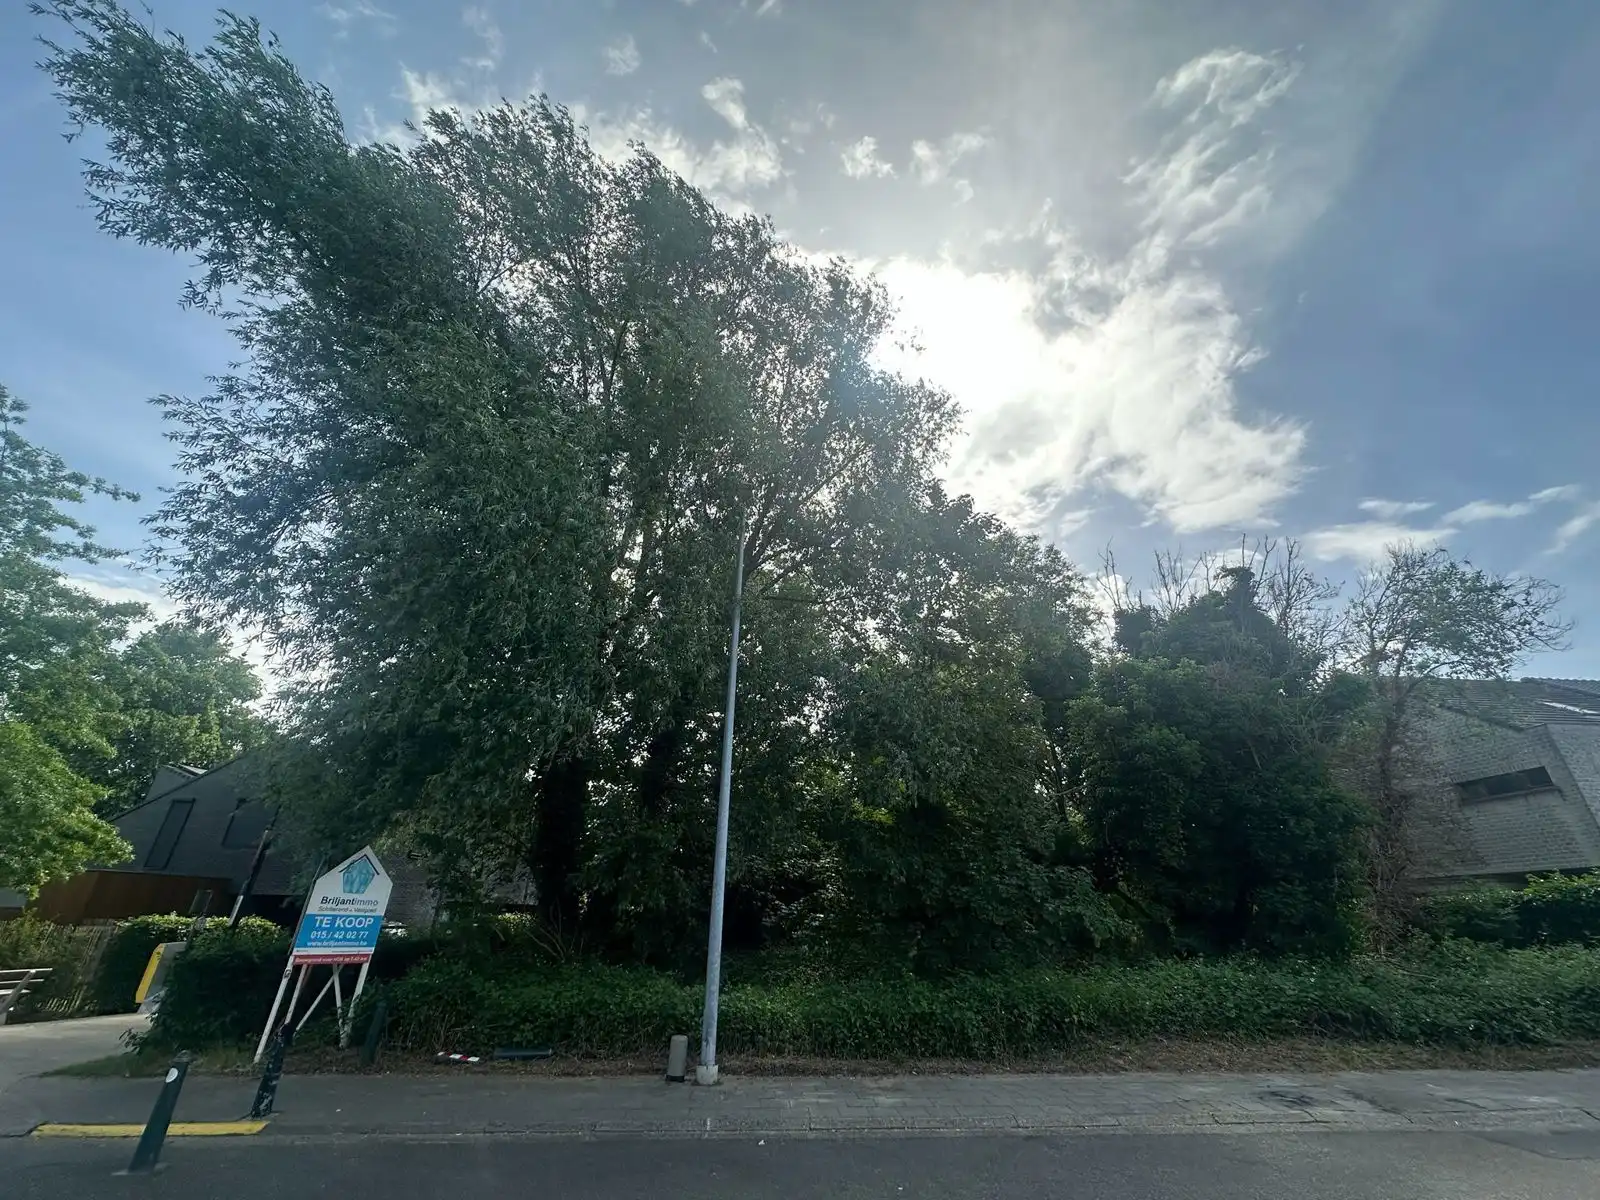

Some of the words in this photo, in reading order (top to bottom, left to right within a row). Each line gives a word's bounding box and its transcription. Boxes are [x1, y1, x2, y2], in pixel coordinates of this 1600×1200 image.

[320, 896, 379, 906] Briljantimmo
[315, 916, 332, 927] TE
[335, 917, 374, 927] KOOP
[311, 931, 327, 939] 015
[334, 931, 345, 939] 42
[346, 931, 357, 939] 02
[359, 931, 369, 939] 77
